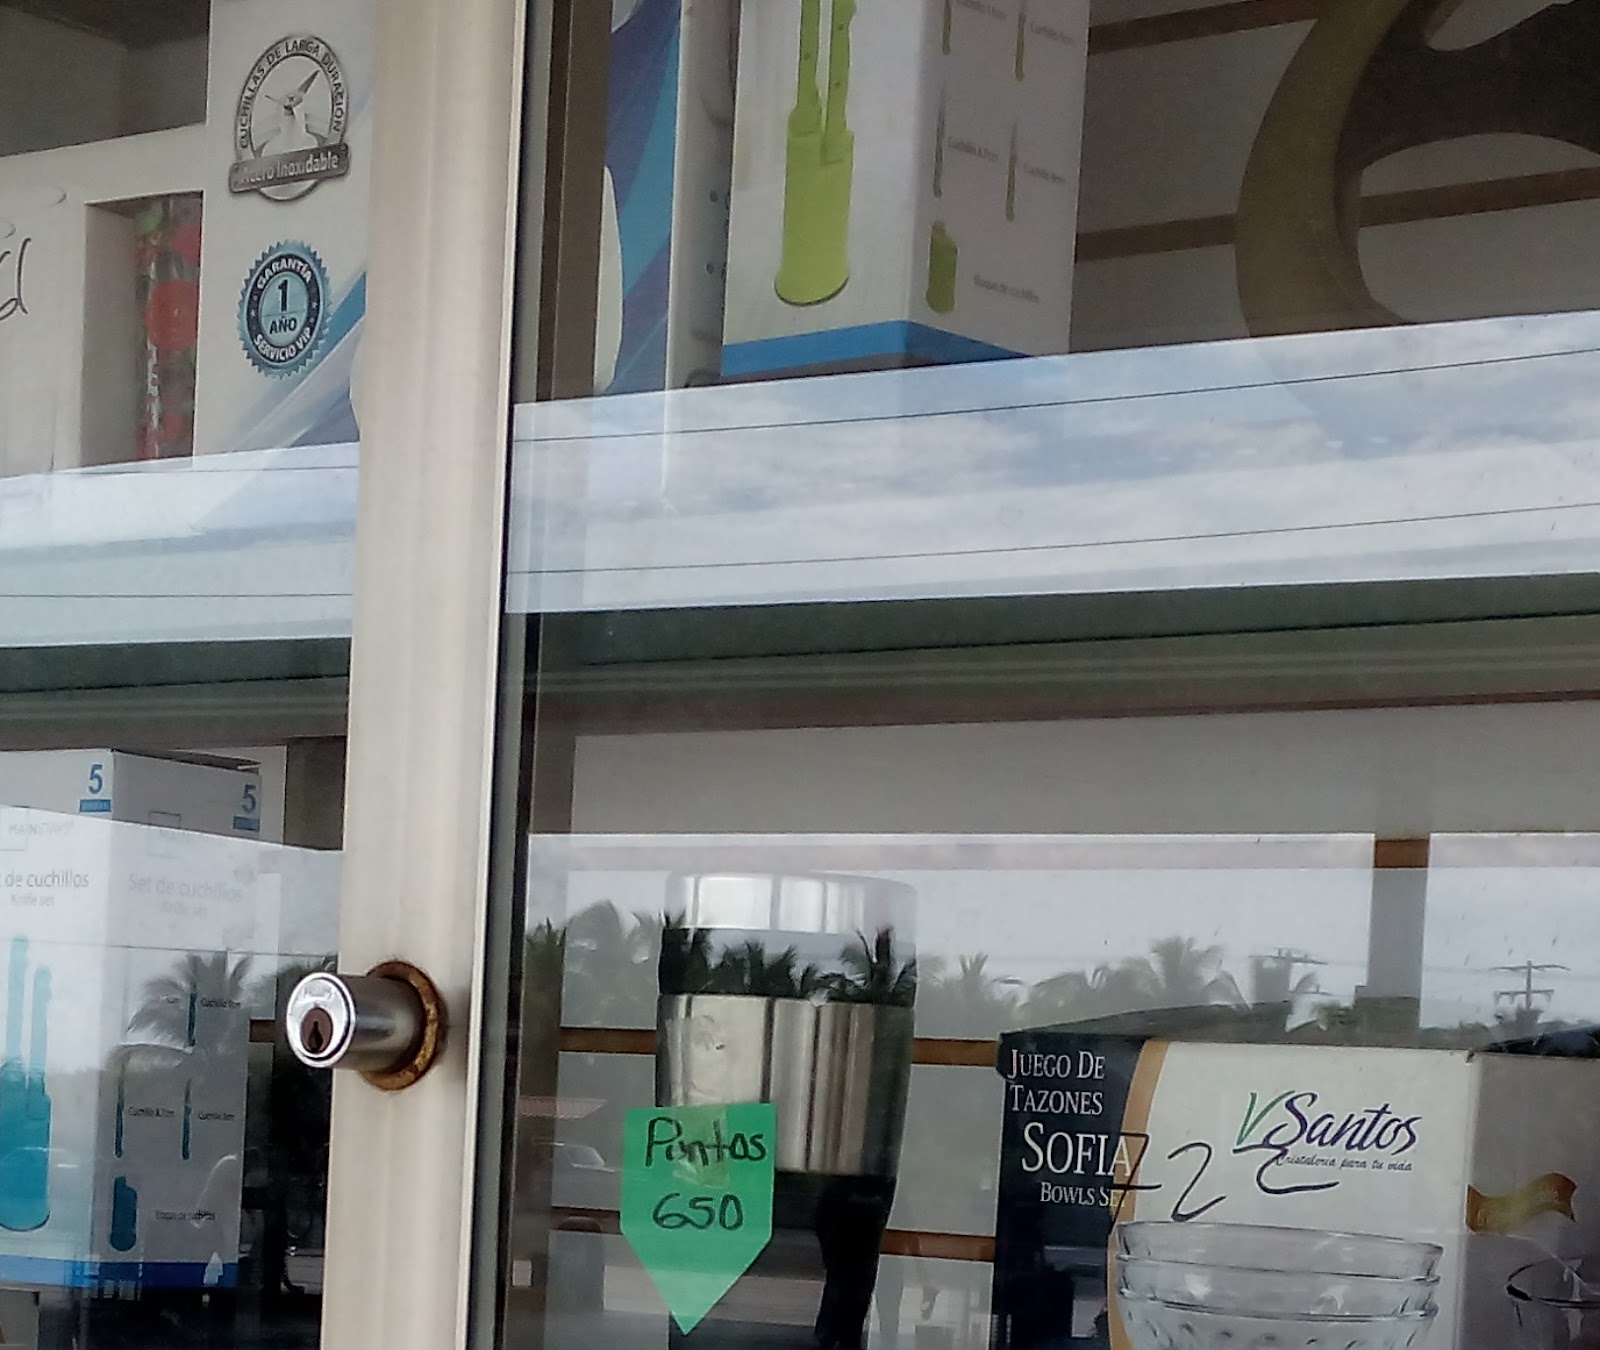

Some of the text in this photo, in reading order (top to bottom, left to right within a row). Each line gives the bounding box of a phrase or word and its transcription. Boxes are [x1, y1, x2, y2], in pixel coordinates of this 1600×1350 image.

[240, 66, 265, 149] CUCHILLAS
[266, 47, 281, 66] DE
[285, 39, 321, 57] LARGA
[277, 151, 339, 178] Inoxidable
[278, 280, 288, 312] 1
[270, 315, 297, 334] AÑO
[254, 327, 311, 361] SERVICIO VIP
[89, 764, 103, 794] 5
[241, 784, 257, 813] 5
[5, 872, 25, 888] de
[28, 870, 89, 888] cuchillos
[129, 873, 243, 901] Set de cuchillos
[1007, 1049, 1105, 1081] JUEGO DE
[1009, 1084, 1104, 1116] TAZONES
[1021, 1122, 1133, 1177] SOFIA
[1339, 1157, 1369, 1171] para
[1387, 1160, 1412, 1172] vida
[1040, 1181, 1096, 1205] BOWLS
[652, 1192, 743, 1231] 650
